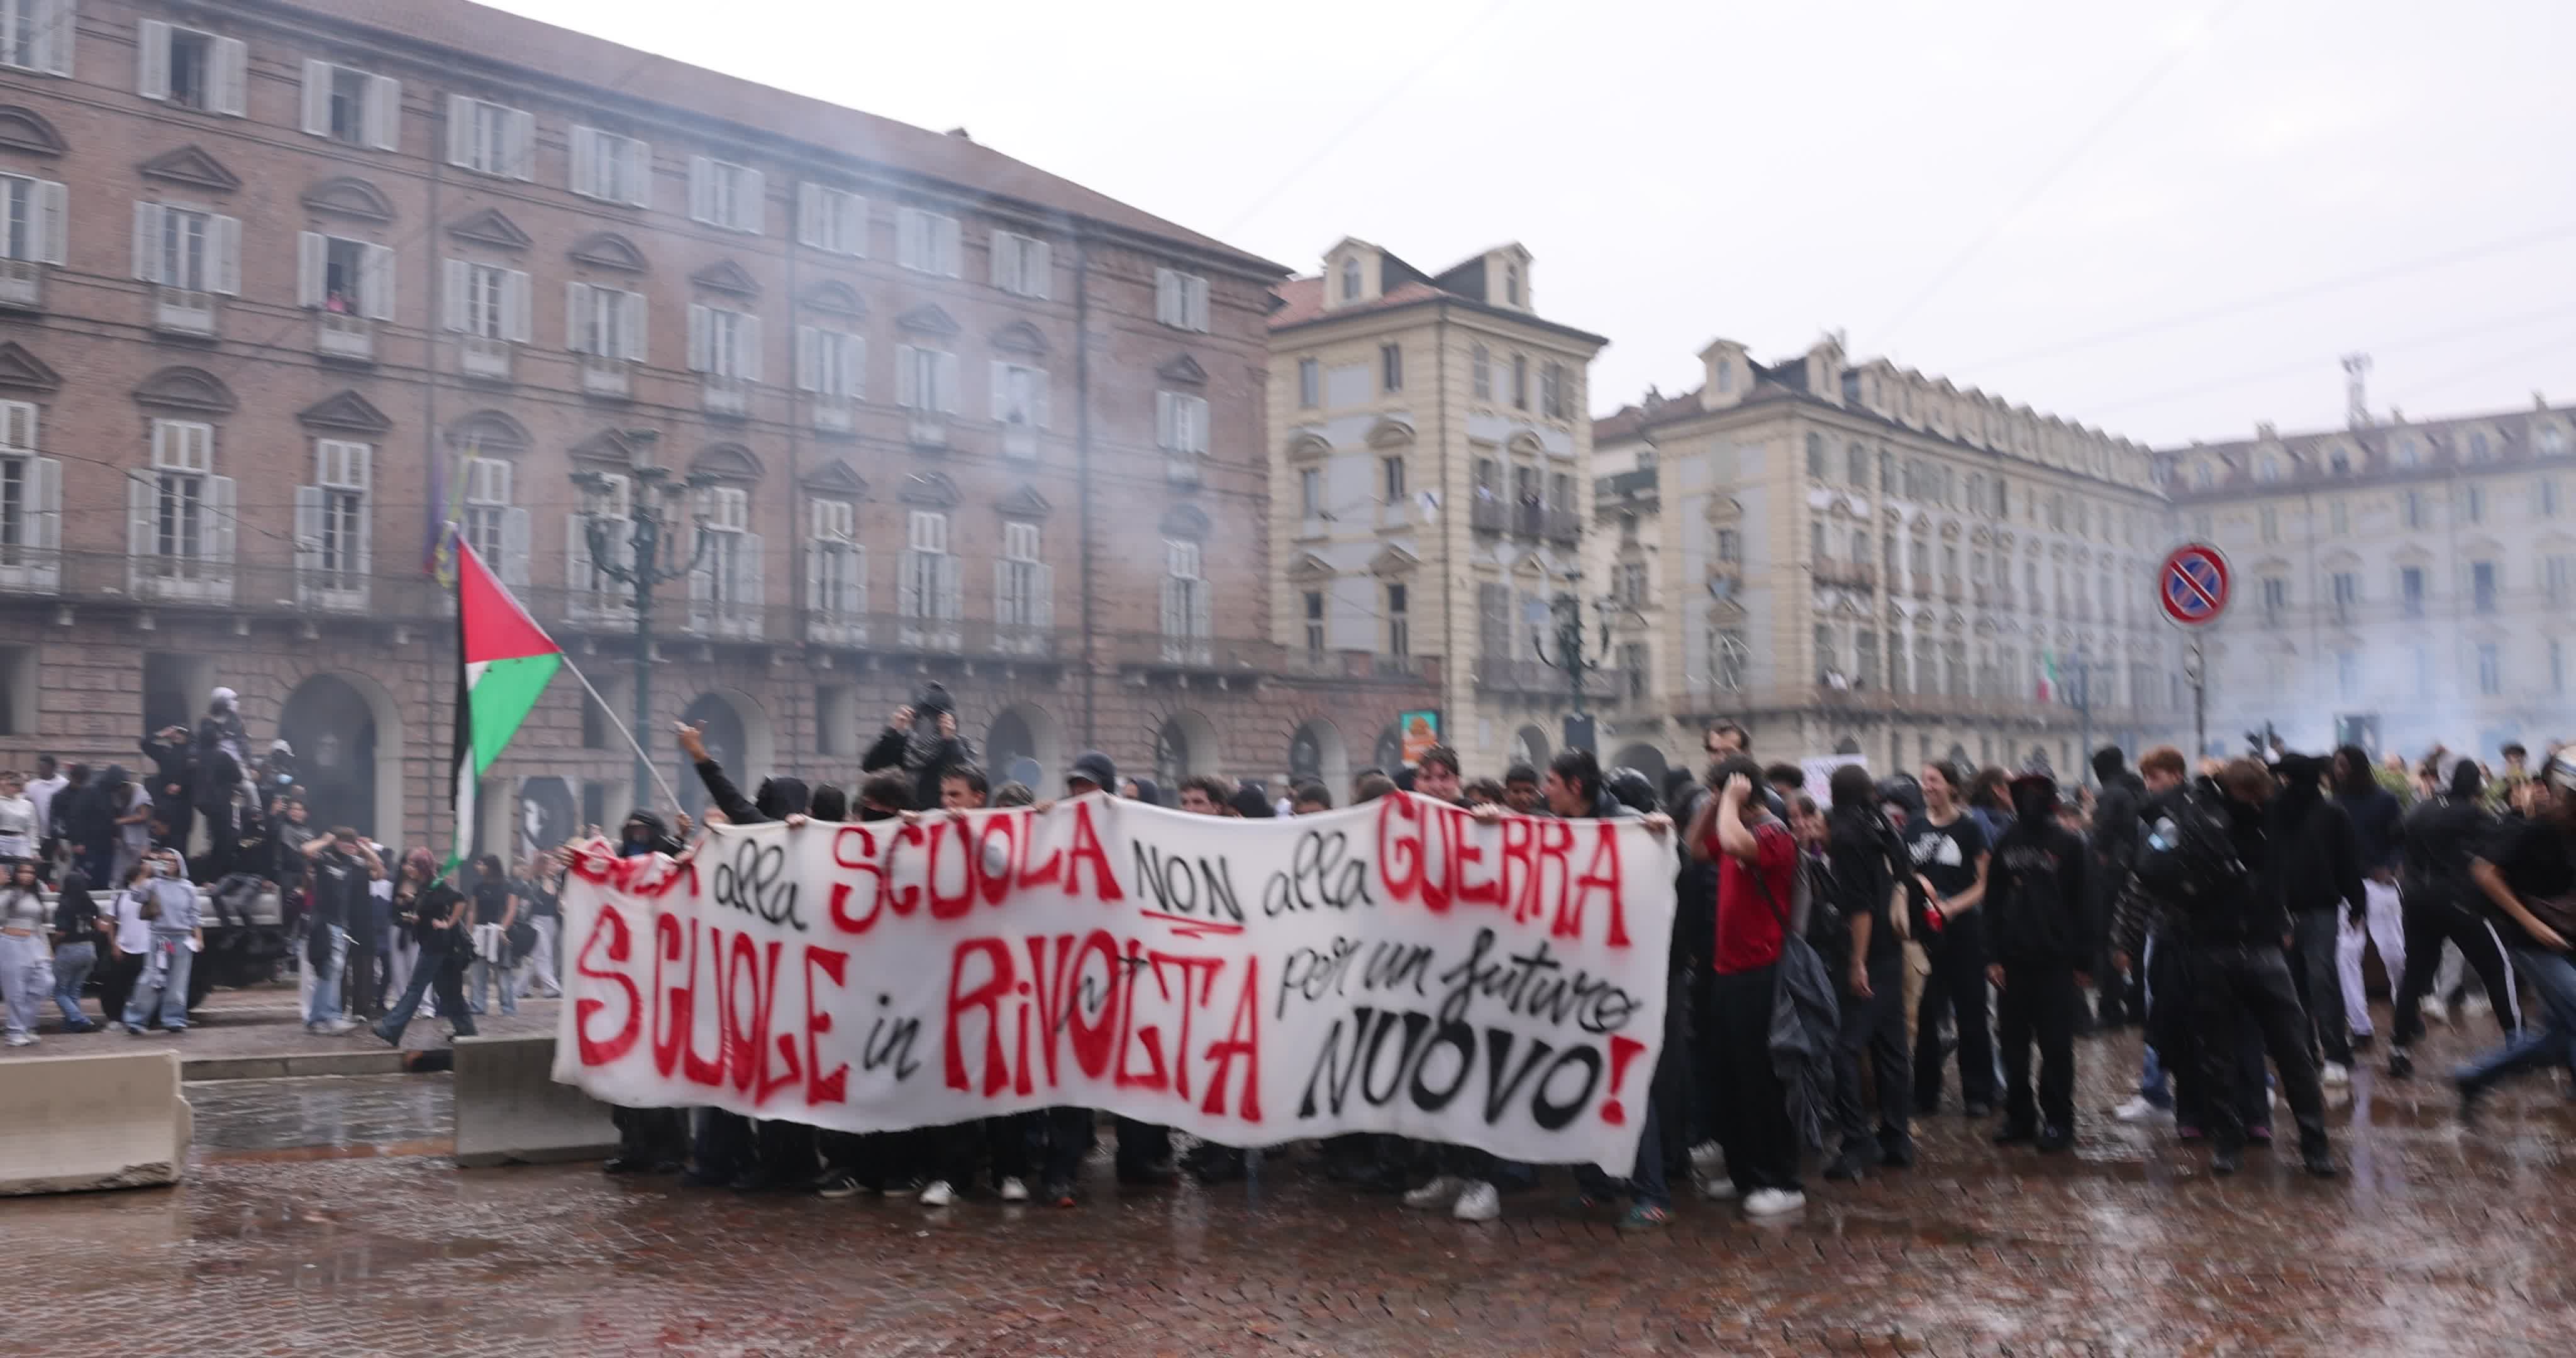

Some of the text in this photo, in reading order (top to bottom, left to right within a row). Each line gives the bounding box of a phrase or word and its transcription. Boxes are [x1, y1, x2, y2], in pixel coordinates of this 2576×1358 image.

[714, 838, 809, 931] alla
[830, 801, 1124, 934] SCUOLA
[1133, 839, 1246, 922] NON
[1263, 830, 1375, 917] alla
[1379, 790, 1631, 947] GUERRA
[575, 904, 849, 1107] SCUOLE
[863, 993, 922, 1082] in
[1277, 927, 1642, 1033] per un futuro
[1298, 1007, 1646, 1130] NUOVO!
